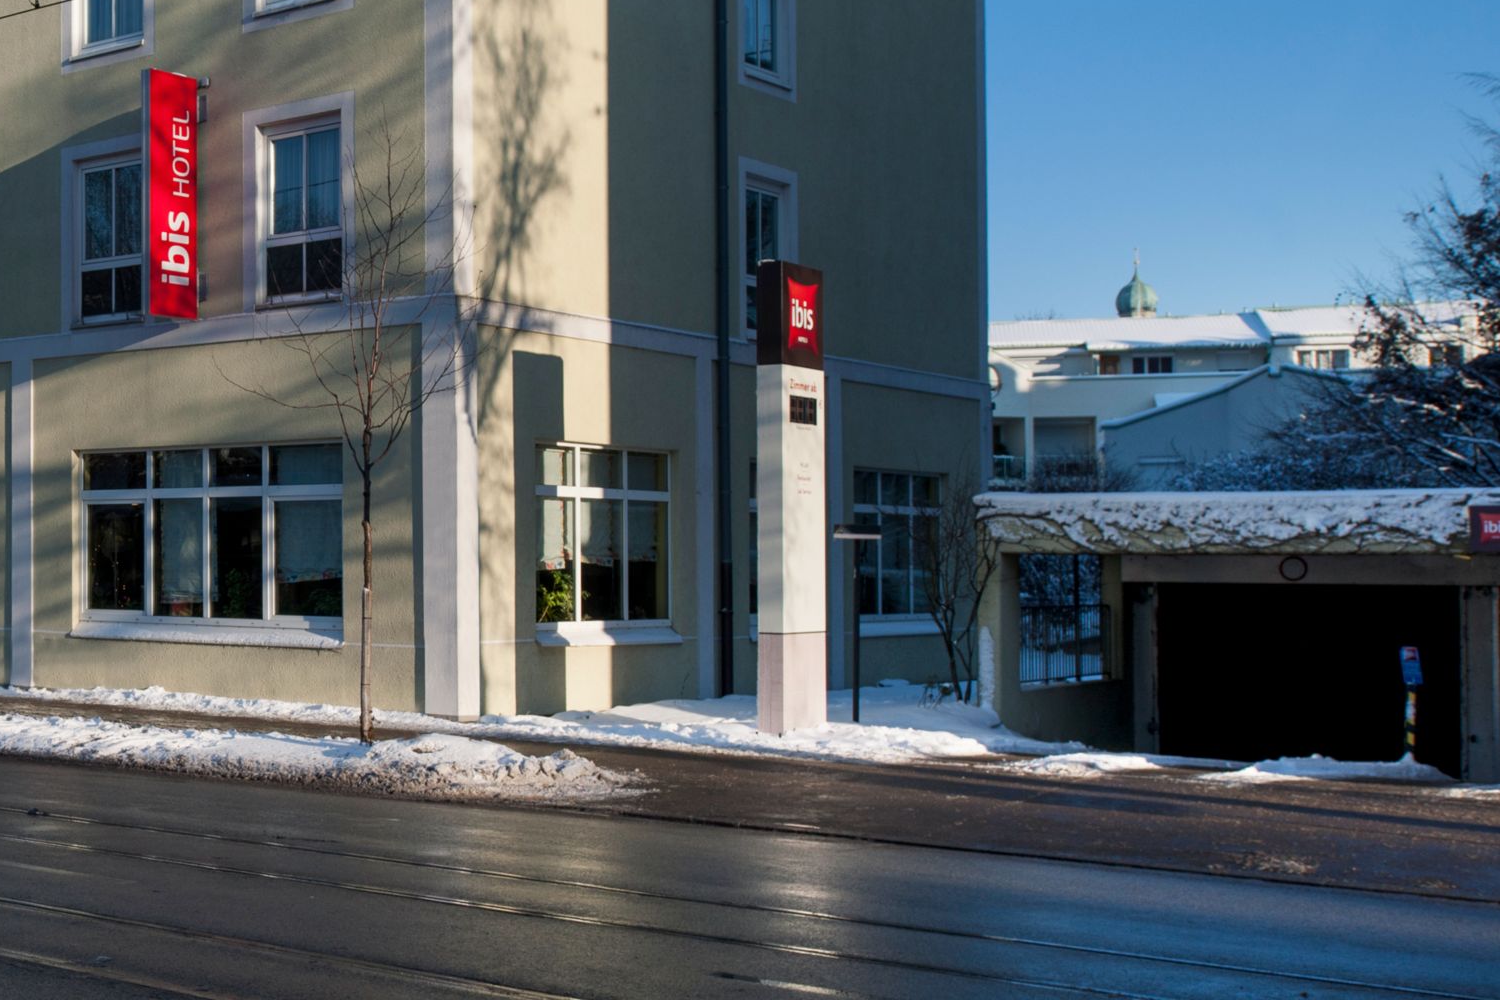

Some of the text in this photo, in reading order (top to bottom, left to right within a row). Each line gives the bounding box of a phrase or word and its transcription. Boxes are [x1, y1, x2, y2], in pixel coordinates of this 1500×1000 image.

[161, 110, 190, 287] ibis HOTEL
[792, 298, 814, 331] ibis
